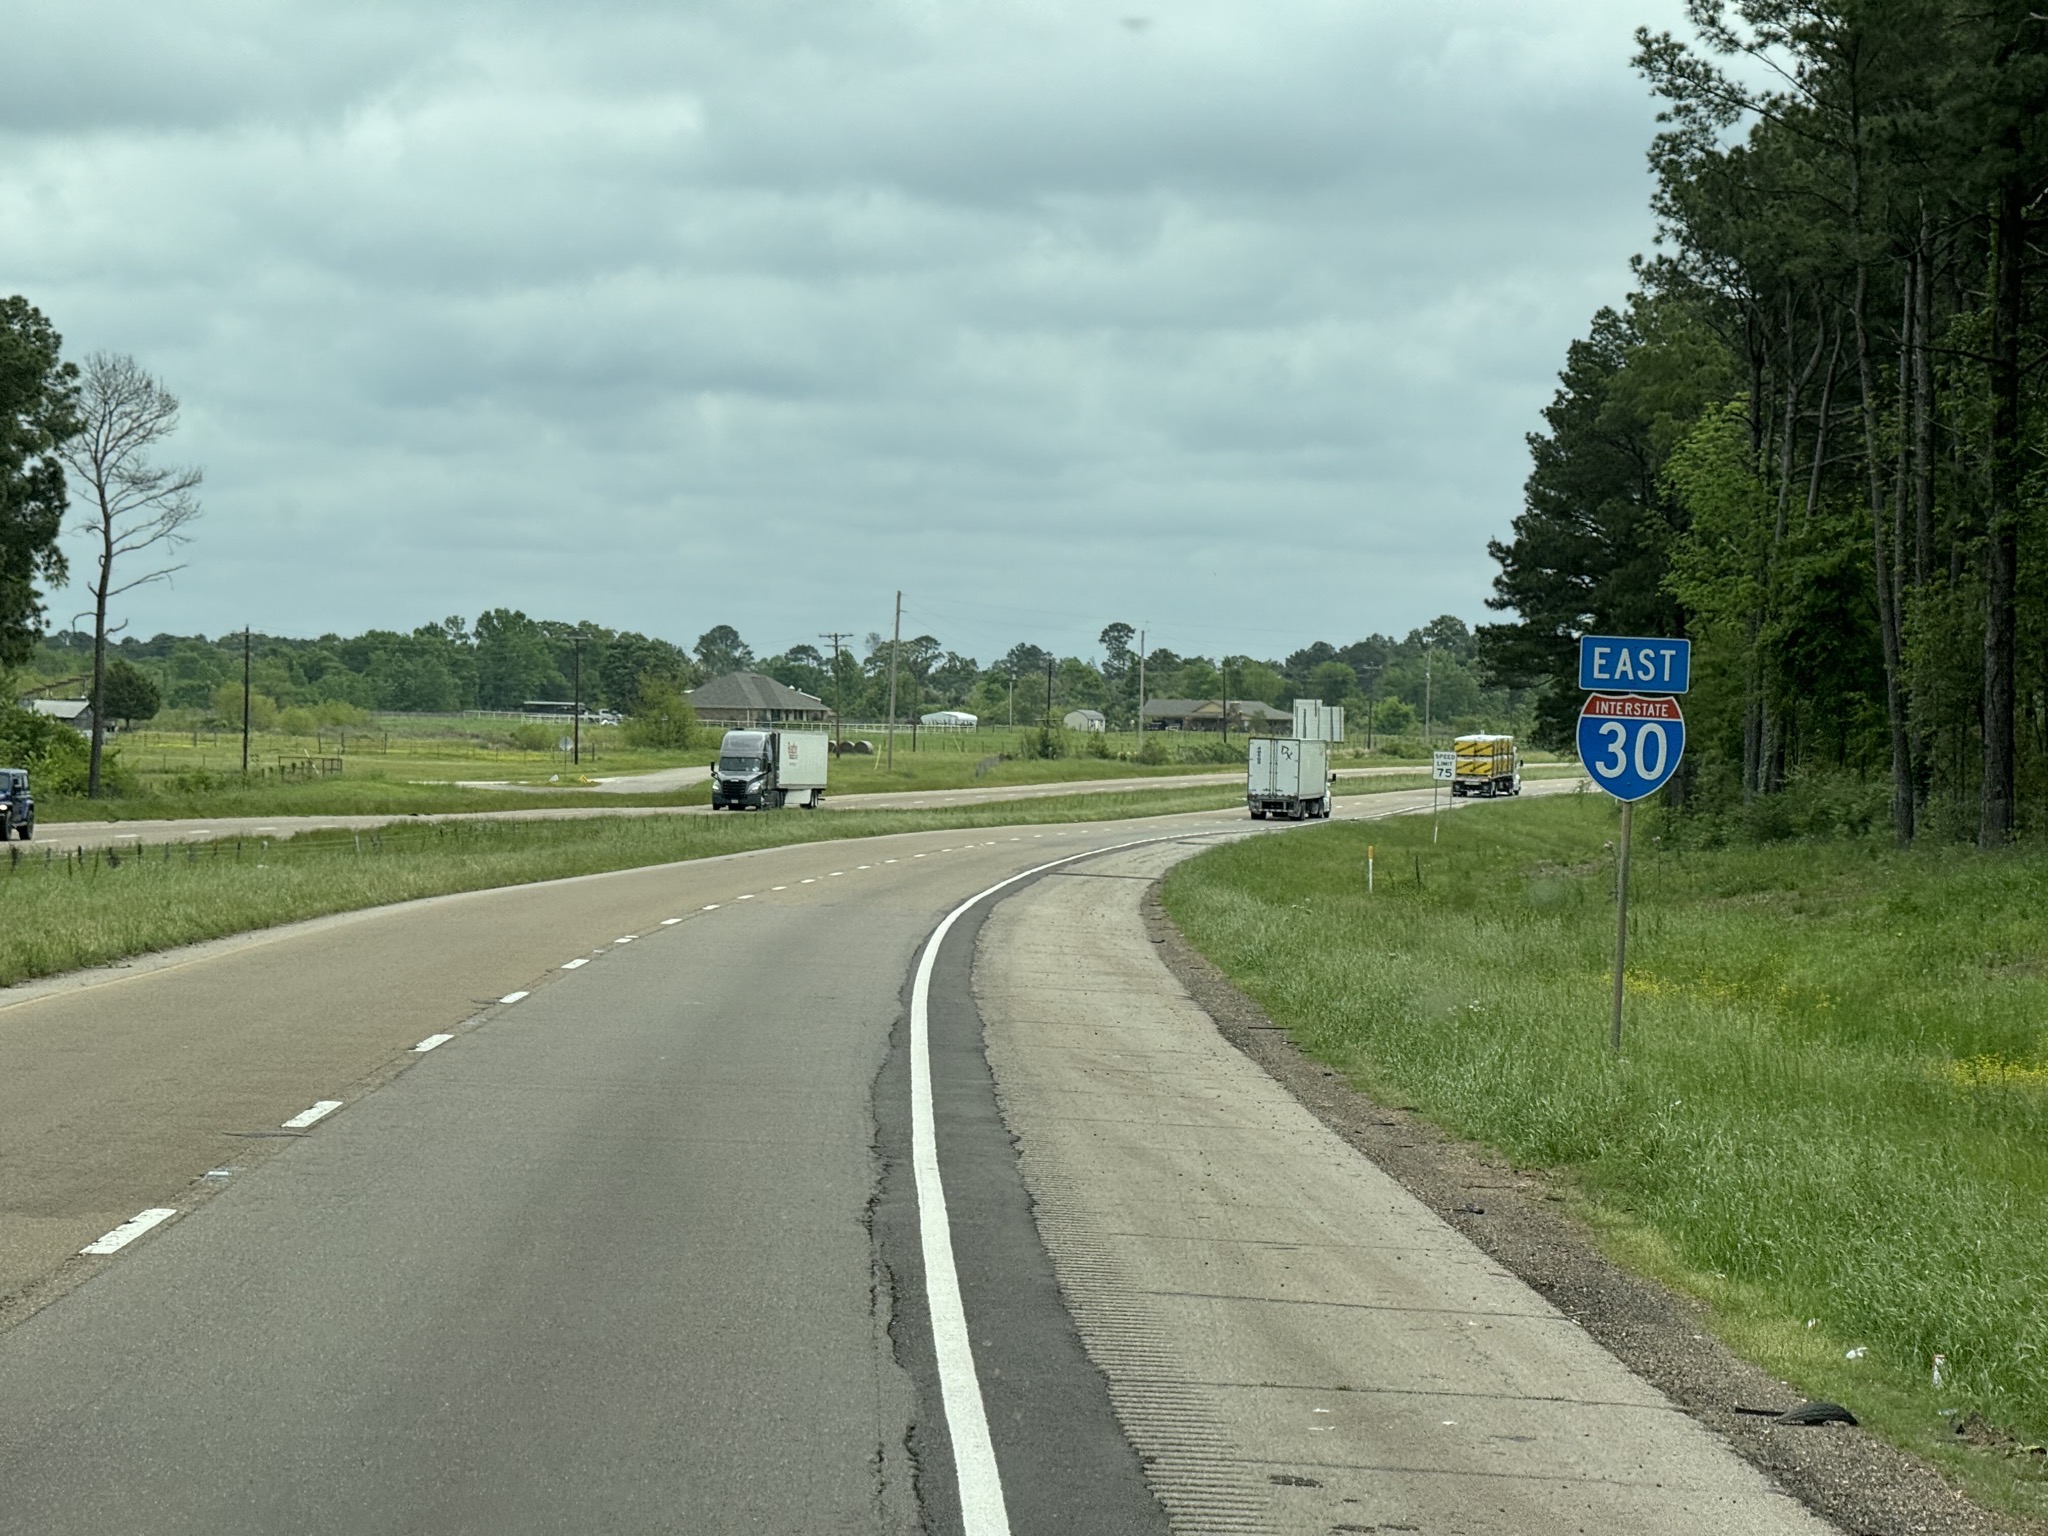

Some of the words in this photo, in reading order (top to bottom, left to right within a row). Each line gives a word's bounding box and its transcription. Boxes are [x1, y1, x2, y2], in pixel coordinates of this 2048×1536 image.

[1593, 647, 1676, 681] EAST
[1595, 701, 1669, 717] INTERSTATE
[1595, 721, 1667, 780] 30
[1436, 768, 1452, 778] 75
